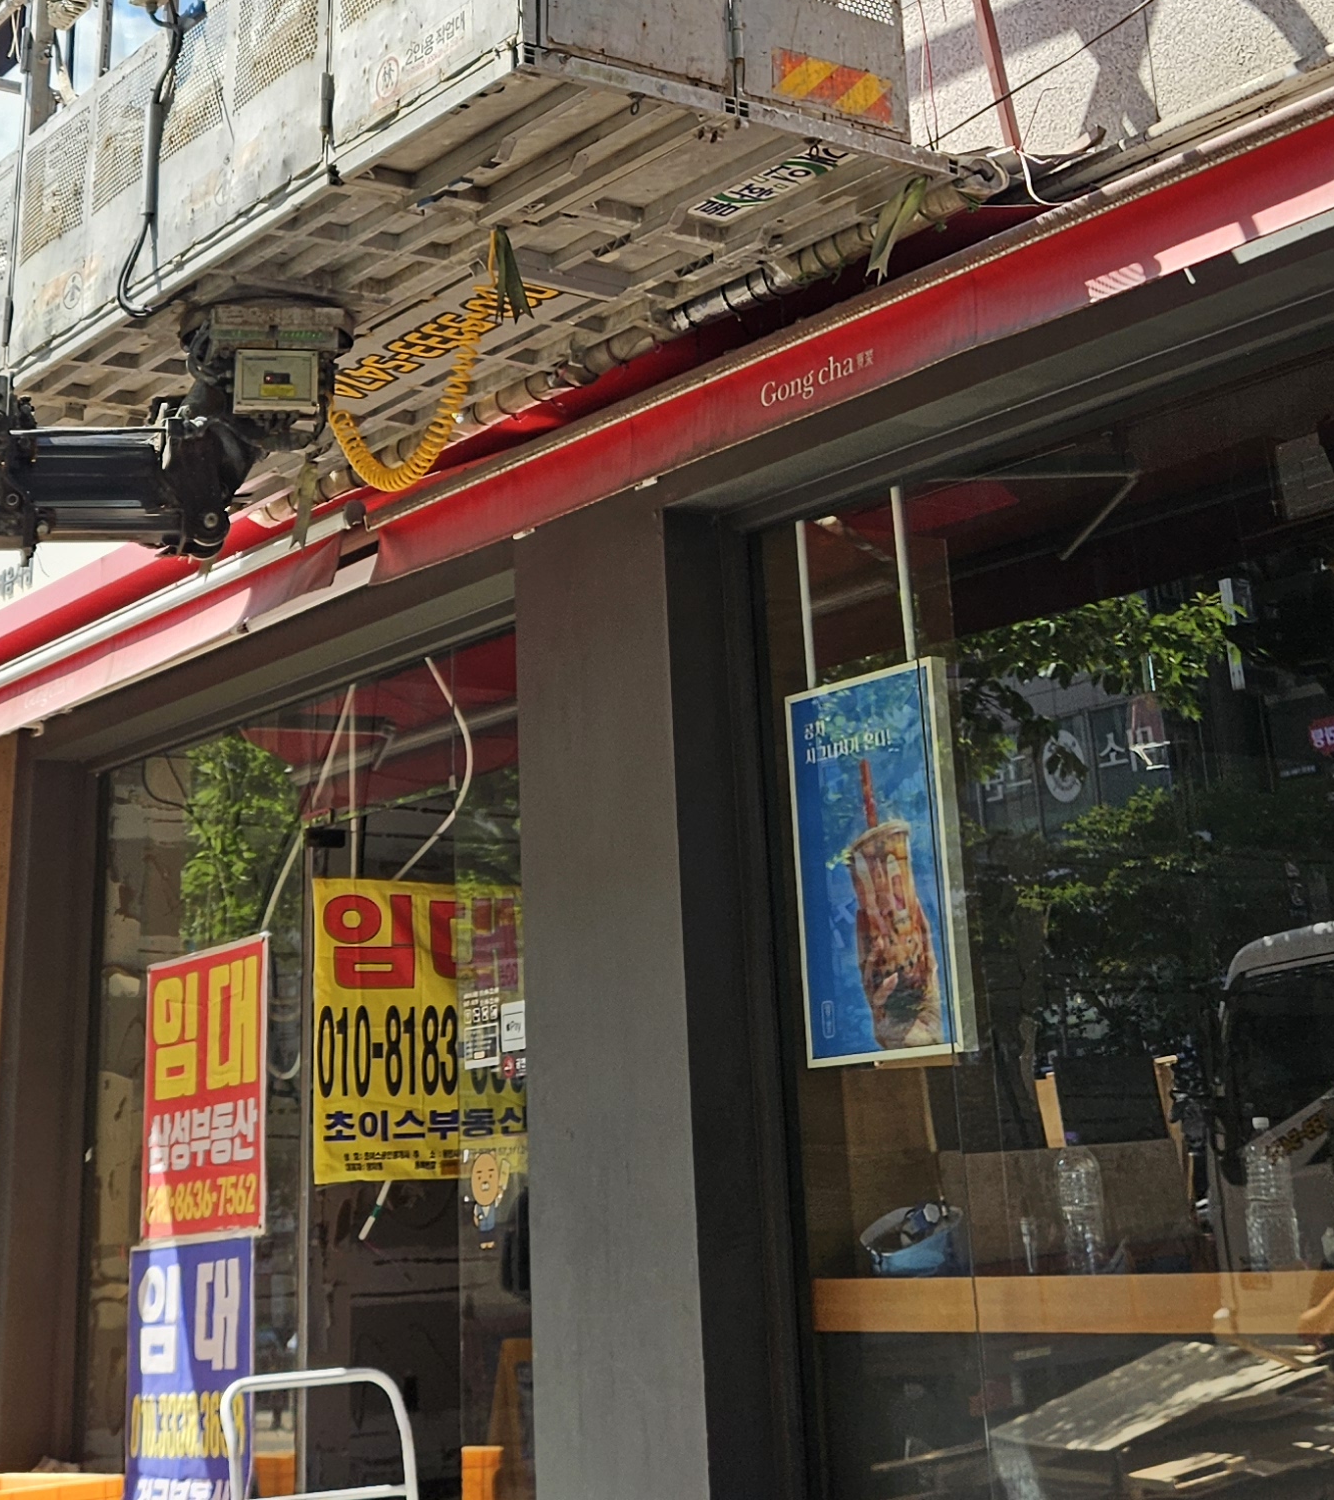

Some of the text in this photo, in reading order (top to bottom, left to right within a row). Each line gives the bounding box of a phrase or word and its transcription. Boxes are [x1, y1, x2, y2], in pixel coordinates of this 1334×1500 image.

[760, 369, 815, 409] Gong
[818, 353, 854, 383] cha
[323, 894, 519, 990] 임대
[153, 954, 259, 1100] 임대
[137, 1256, 241, 1375] 임대
